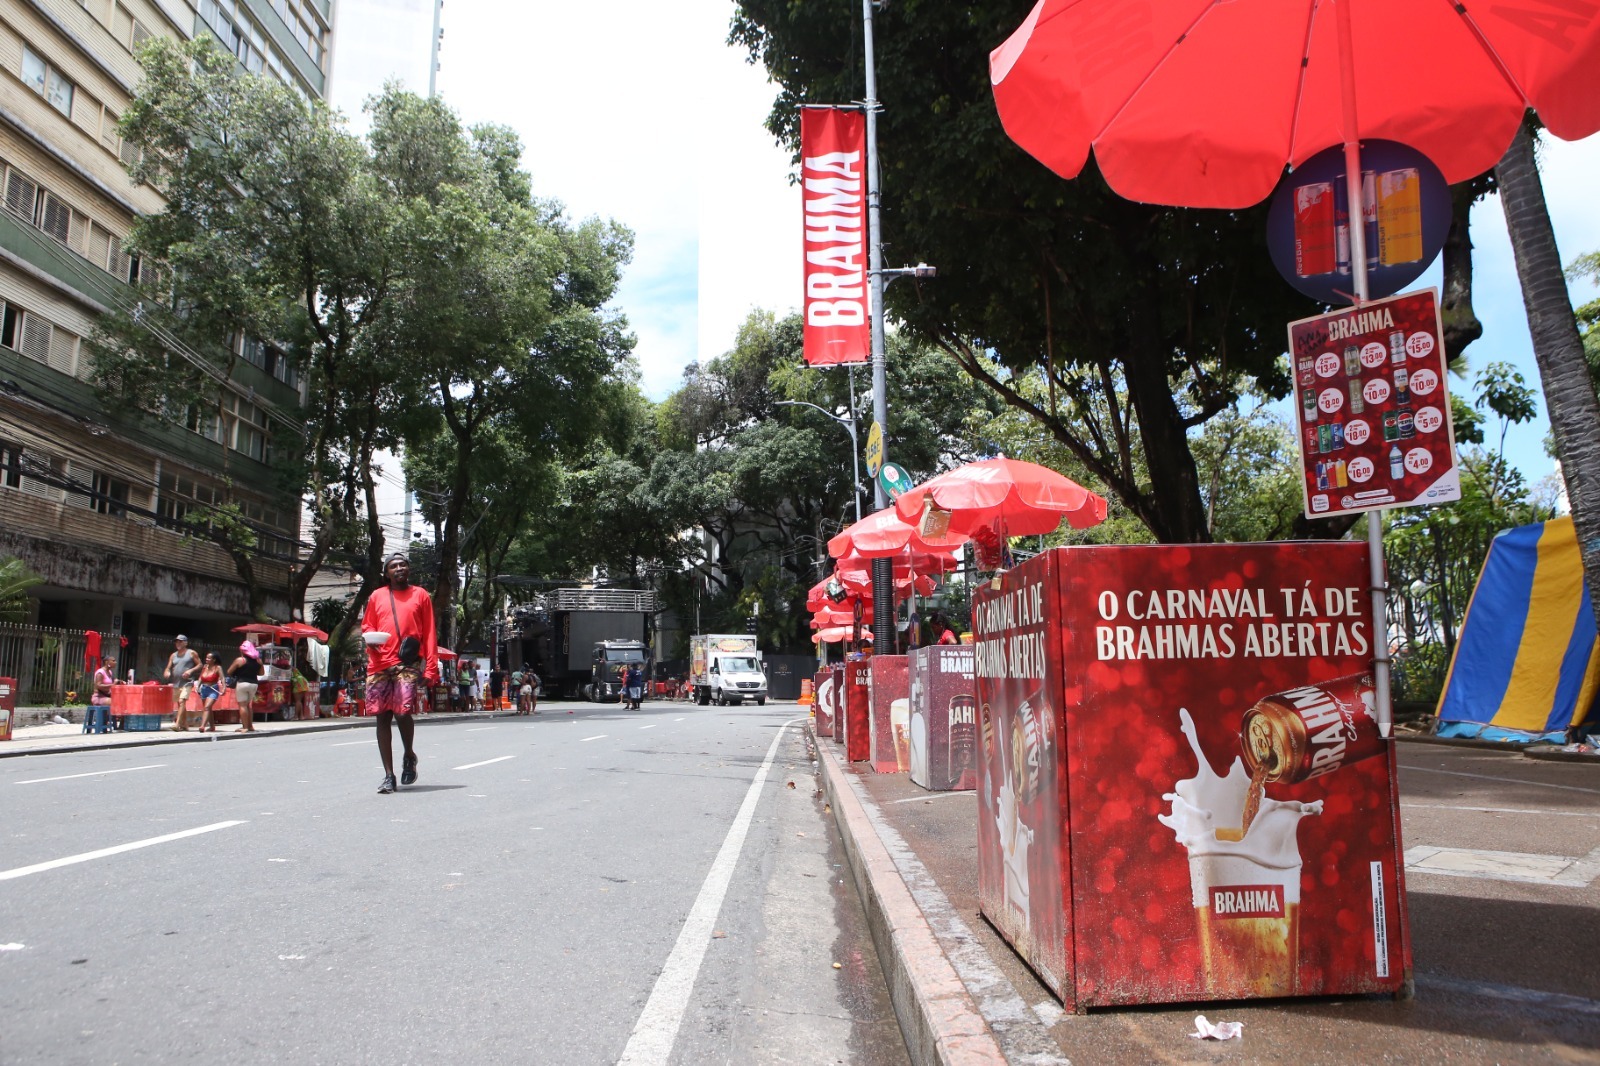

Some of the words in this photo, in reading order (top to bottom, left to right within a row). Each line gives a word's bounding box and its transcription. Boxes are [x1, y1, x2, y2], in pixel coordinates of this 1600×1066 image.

[805, 150, 864, 327] BRAHMA
[1328, 307, 1395, 341] BRAHMA
[976, 603, 982, 635] O
[981, 592, 1016, 635] CARNAVAL
[1017, 575, 1030, 627] TÁ
[1030, 581, 1044, 624] DE
[1098, 590, 1119, 621] O
[1126, 588, 1274, 620] CARNAVAL
[1280, 579, 1318, 617] TÁ
[1324, 587, 1362, 617] DE
[975, 637, 1007, 679] BRAHMAS
[1009, 631, 1046, 679] ABERTAS
[1096, 622, 1237, 661] BRAHMAS
[1244, 621, 1368, 658] ABERTAS
[1214, 890, 1280, 914] BRAHMA
